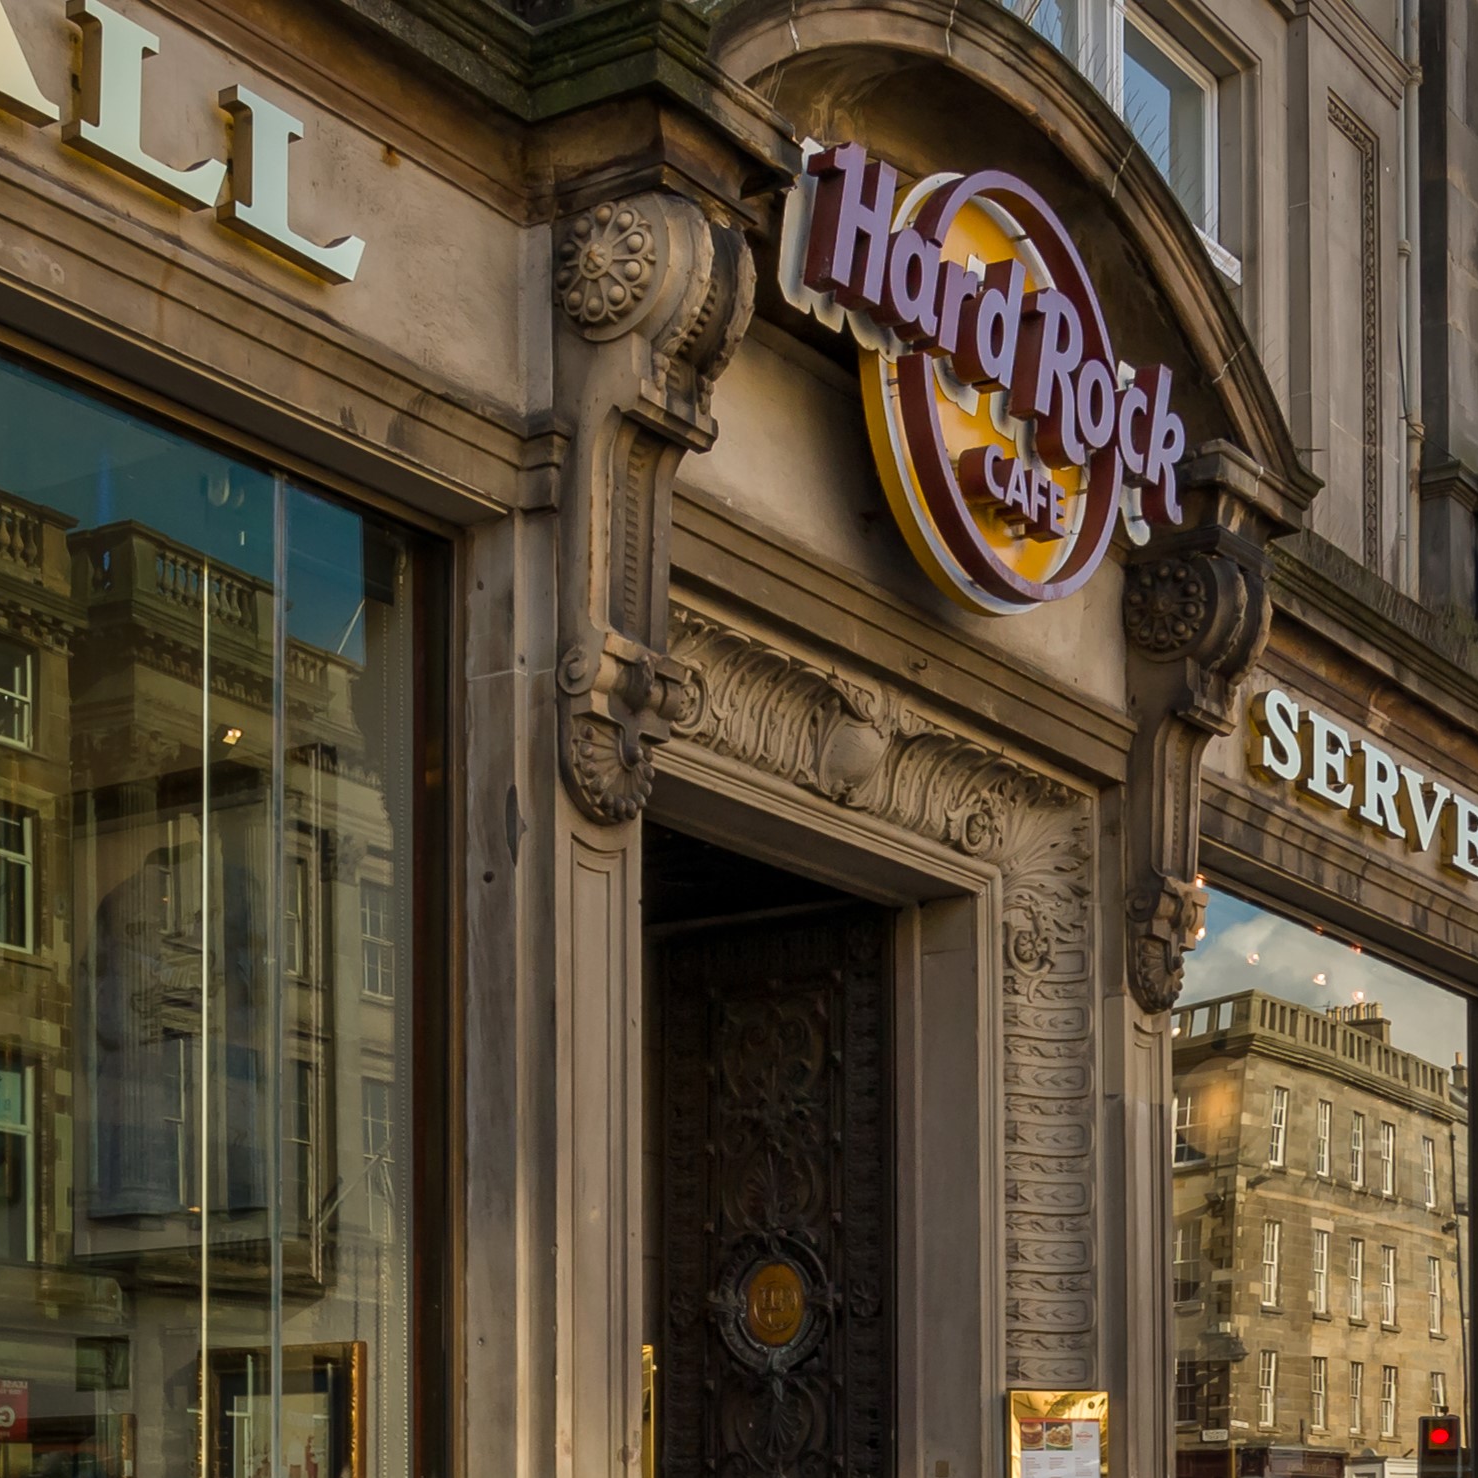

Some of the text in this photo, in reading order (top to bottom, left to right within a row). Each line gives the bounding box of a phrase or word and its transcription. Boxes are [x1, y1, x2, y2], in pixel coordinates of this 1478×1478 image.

[806, 141, 1185, 525] Hard Rock
[966, 444, 1066, 540] CAFE
